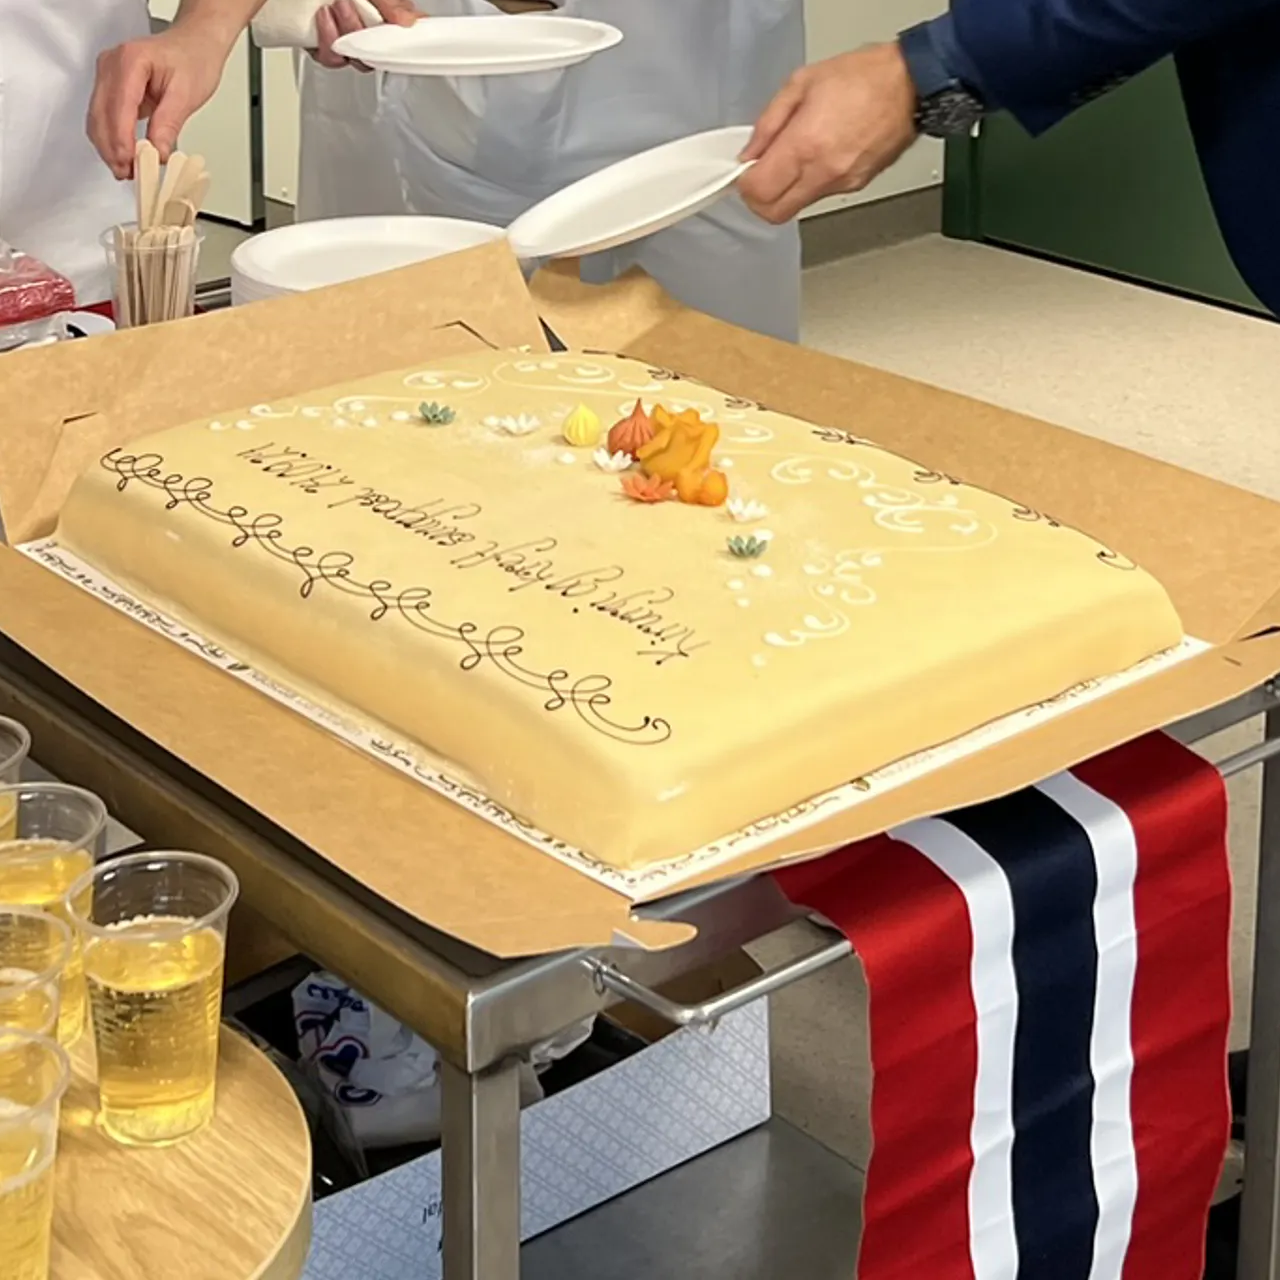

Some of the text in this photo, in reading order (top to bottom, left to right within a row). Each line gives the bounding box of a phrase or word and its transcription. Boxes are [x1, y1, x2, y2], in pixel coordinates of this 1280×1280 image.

[236, 441, 355, 494] 24.09.24
[327, 486, 482, 547] sengepost
[544, 565, 624, 598] og
[572, 586, 712, 666] Kirurgi
